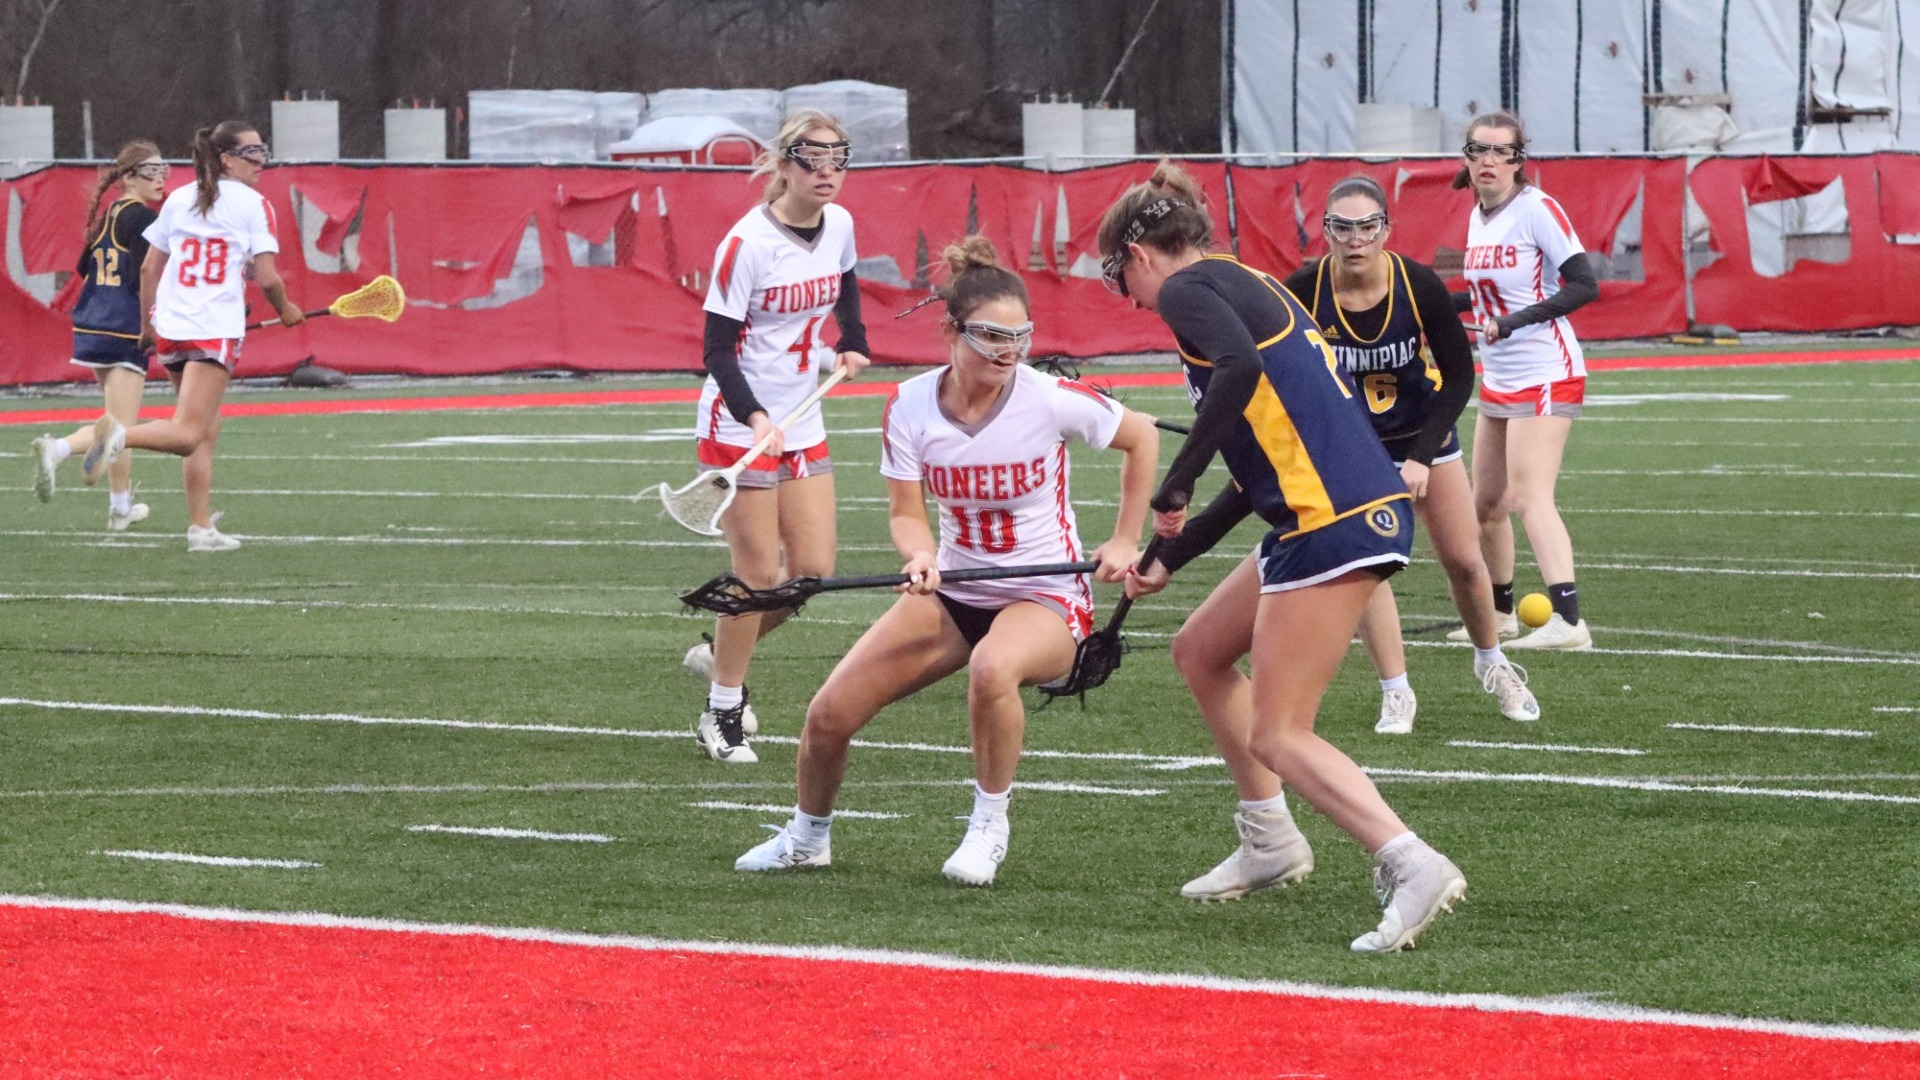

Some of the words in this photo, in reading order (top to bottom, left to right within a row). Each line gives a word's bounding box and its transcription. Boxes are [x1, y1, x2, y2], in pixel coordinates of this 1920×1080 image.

[93, 247, 121, 287] 12
[178, 236, 228, 288] 28
[761, 273, 842, 314] PIONEE
[786, 314, 823, 373] 4
[1362, 373, 1398, 415] 6
[922, 456, 1047, 501] IONEERS
[950, 506, 1017, 554] 10
